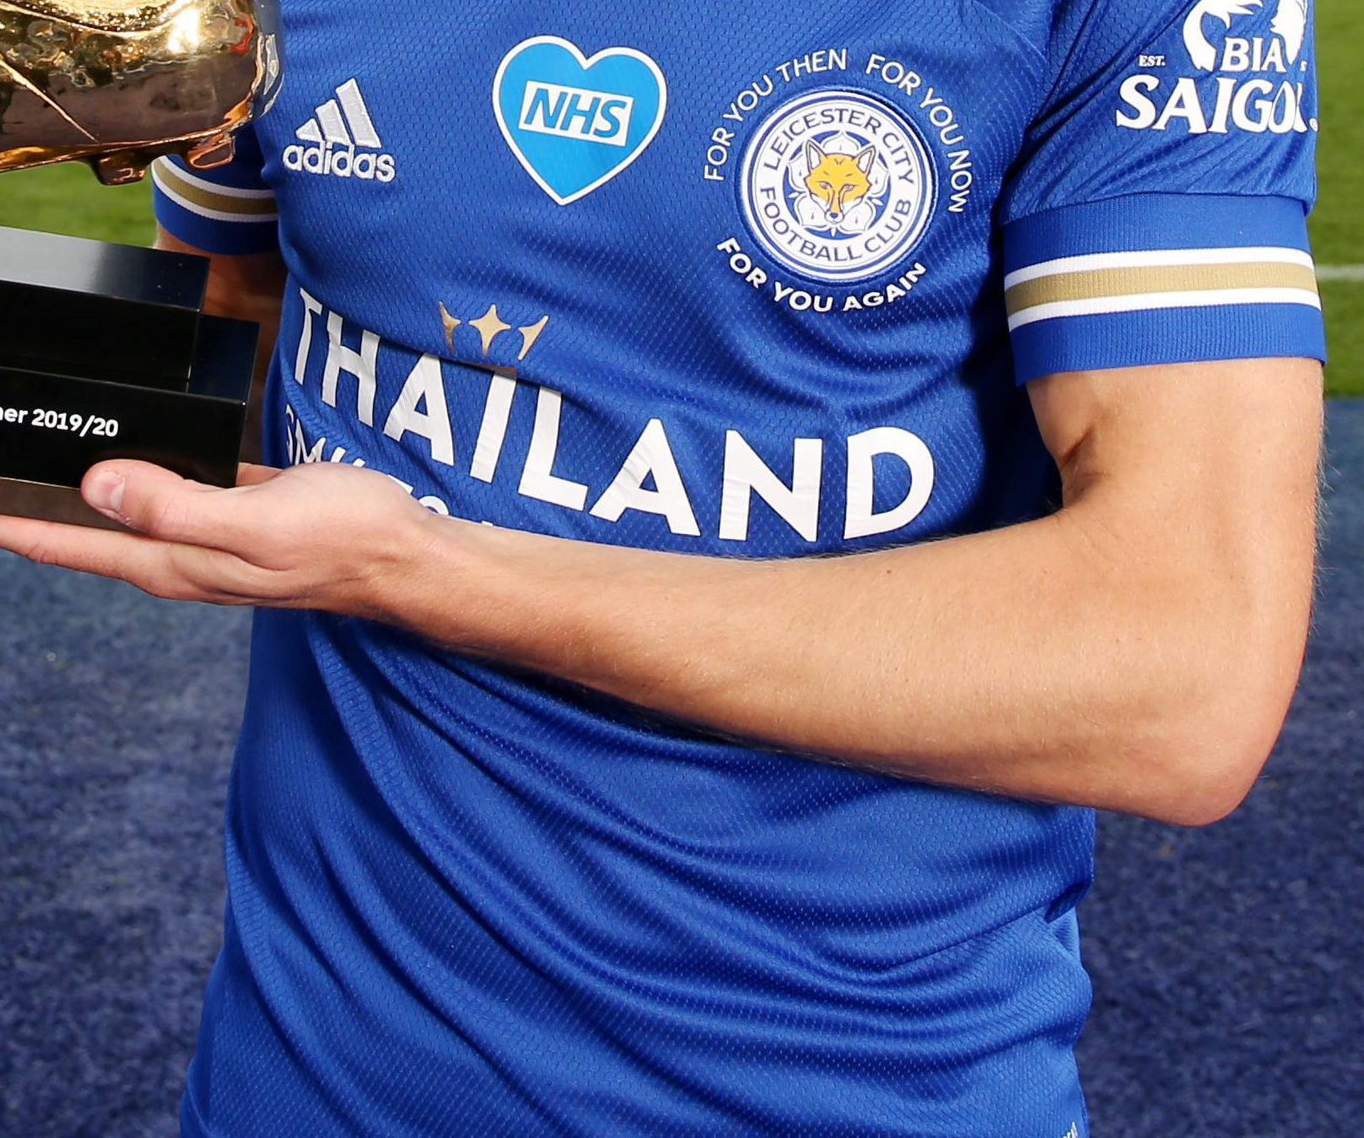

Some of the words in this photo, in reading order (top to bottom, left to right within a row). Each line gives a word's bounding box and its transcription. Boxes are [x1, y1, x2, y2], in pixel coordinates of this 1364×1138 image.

[1139, 55, 1166, 68] EST.
[1220, 37, 1287, 72] BIA
[523, 87, 627, 139] NHS
[703, 126, 735, 181] FOR
[723, 74, 774, 123] YOU
[775, 48, 848, 83] THEN
[763, 108, 882, 171] LEICESTER
[882, 132, 914, 185] CITY
[865, 53, 921, 96] FOR
[920, 88, 964, 146] YOU
[947, 149, 973, 213] NOW
[282, 140, 395, 183] adidas
[760, 186, 862, 262] FOOTBALL
[864, 198, 912, 254] CLUB
[717, 238, 768, 289] FOR
[773, 281, 834, 313] YOU
[842, 262, 927, 311] AGAIN
[32, 408, 119, 439] 2019/20
[294, 287, 936, 543] THAILAND
